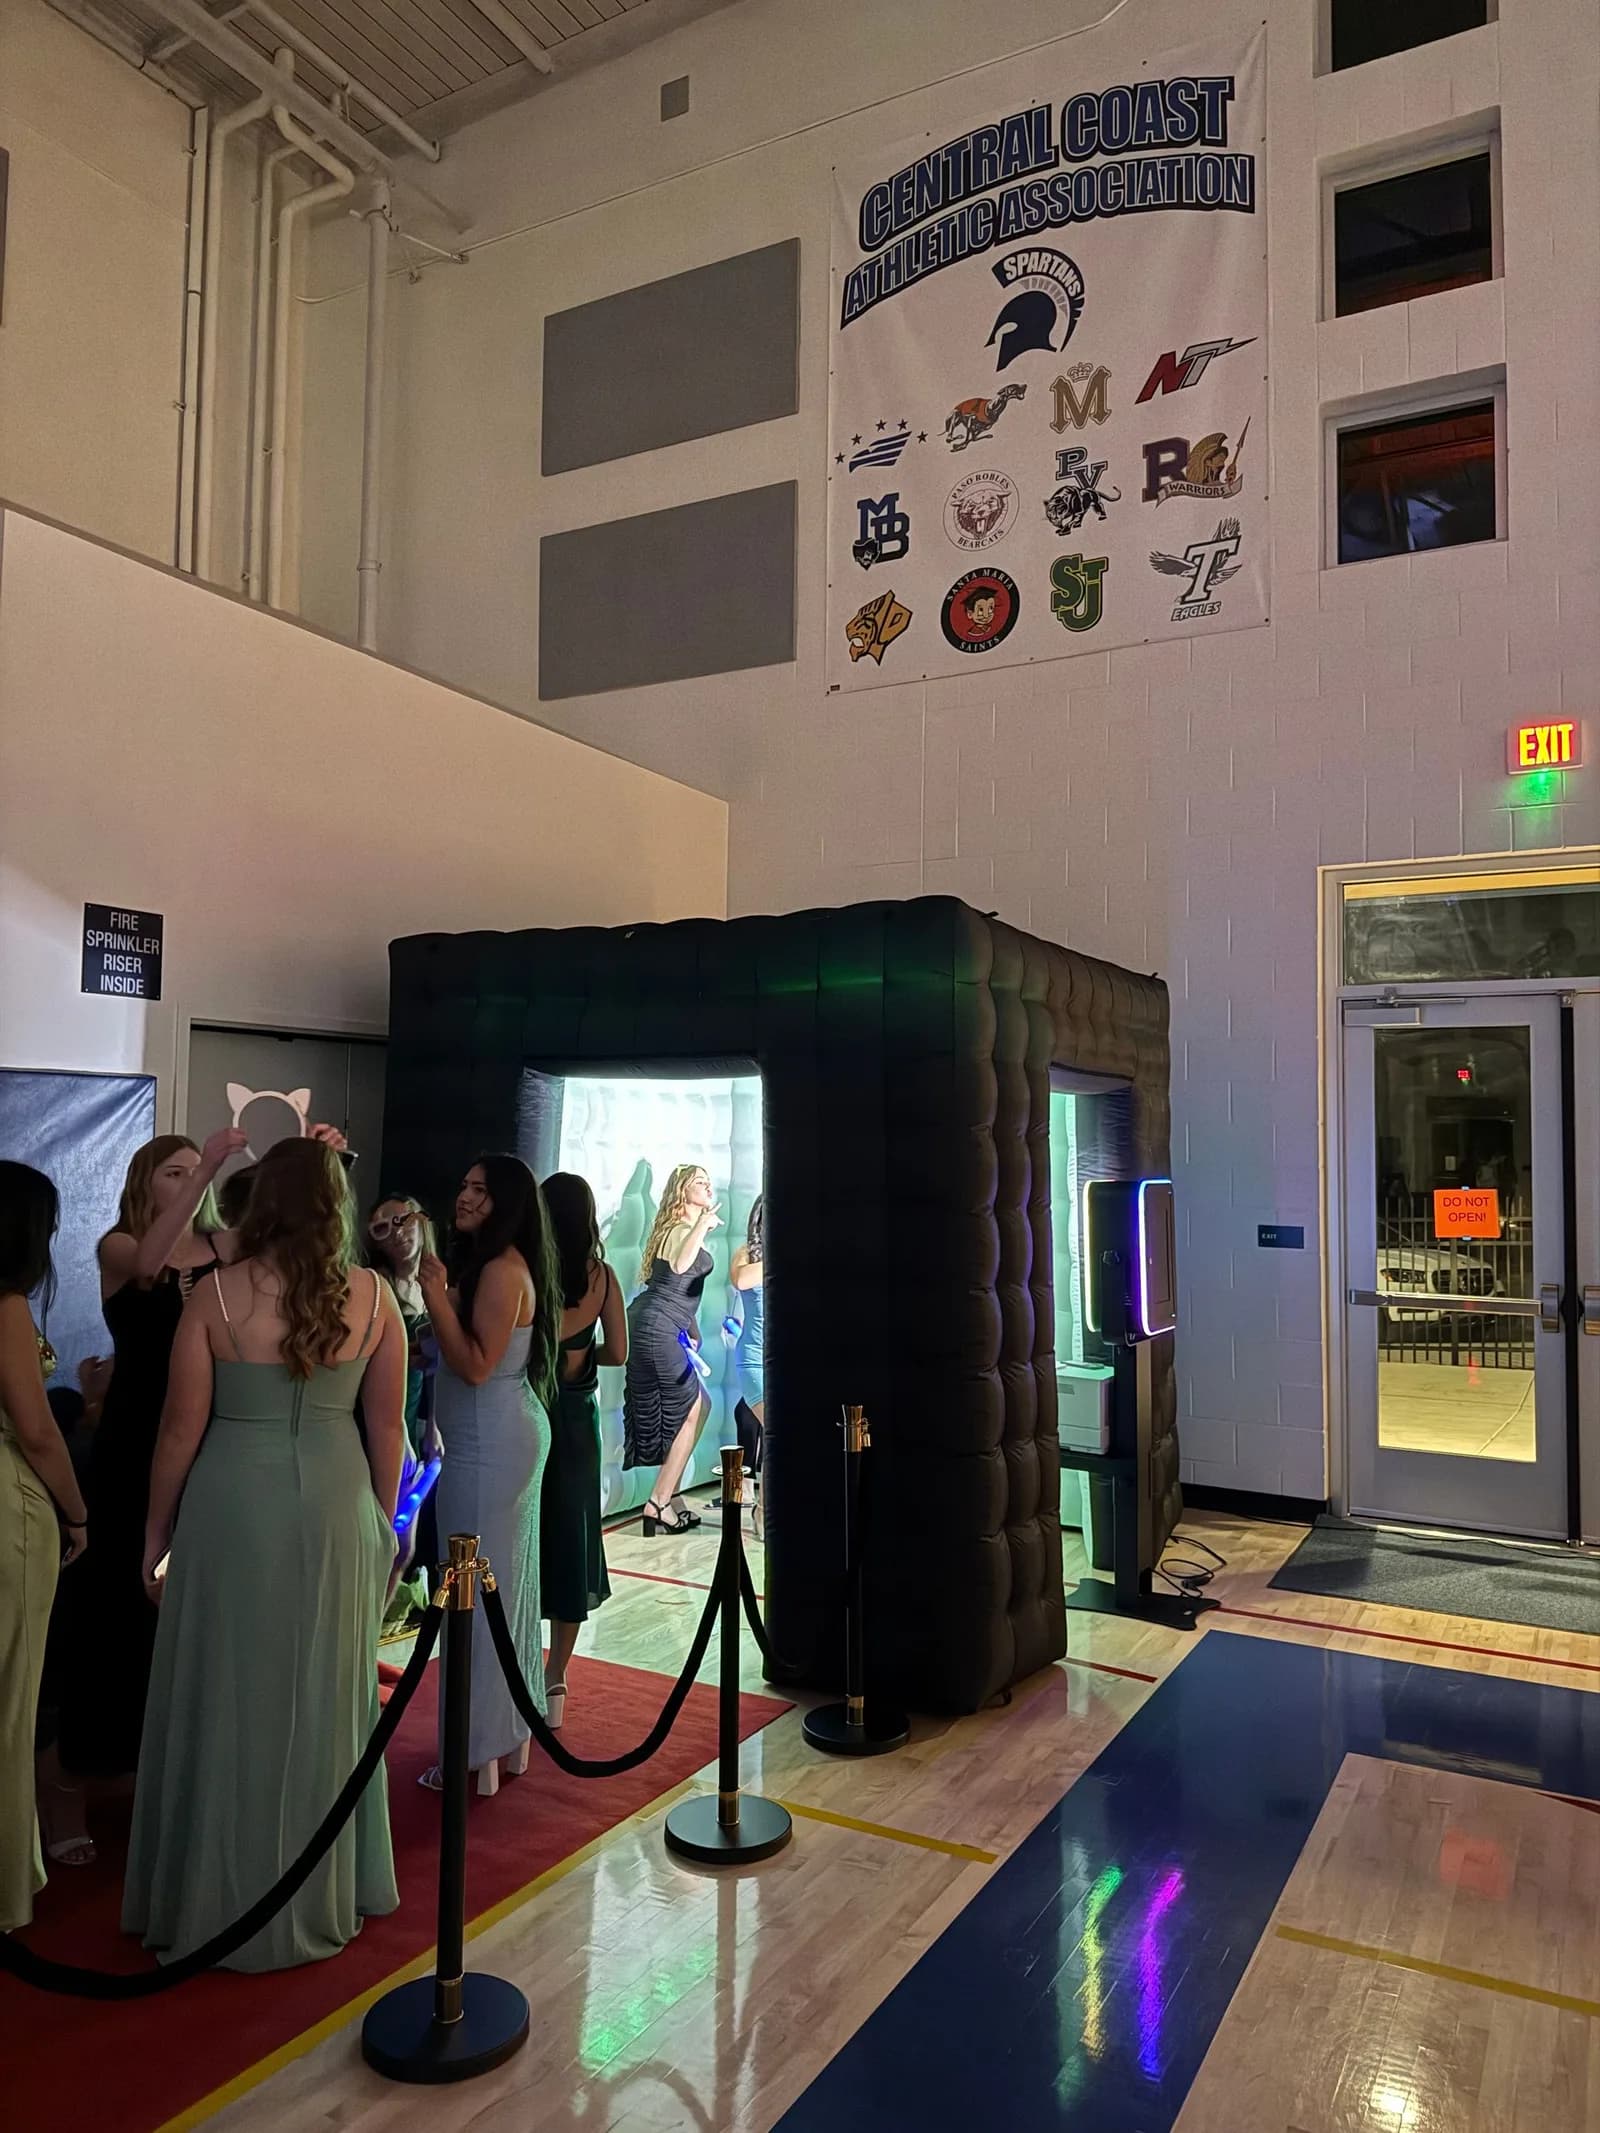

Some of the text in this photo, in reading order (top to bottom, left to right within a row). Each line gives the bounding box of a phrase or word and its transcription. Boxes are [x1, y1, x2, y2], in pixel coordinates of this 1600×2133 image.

[860, 76, 1234, 251] CENTRAL COAST
[841, 155, 1255, 330] ATHLETIC ASSOCIATION
[1003, 251, 1081, 297] SPARTANS
[1049, 365, 1112, 434] M
[952, 472, 1011, 500] PASO ROBLES
[1168, 480, 1226, 497] WARRIORS
[956, 529, 1005, 550] BEARCATS
[946, 568, 1014, 601] SANTA MARIA
[1050, 554, 1109, 632] SJ
[1171, 601, 1222, 621] EAGLES
[959, 636, 1001, 651] SAINTS
[1519, 723, 1574, 767] EXIT
[109, 911, 139, 932] FIRE
[86, 929, 160, 955] SPRINKLER
[103, 953, 143, 974] RISER
[100, 974, 145, 995] INSIDE
[1442, 1197, 1489, 1207] DO NOT
[1448, 1212, 1487, 1222] OPEN!
